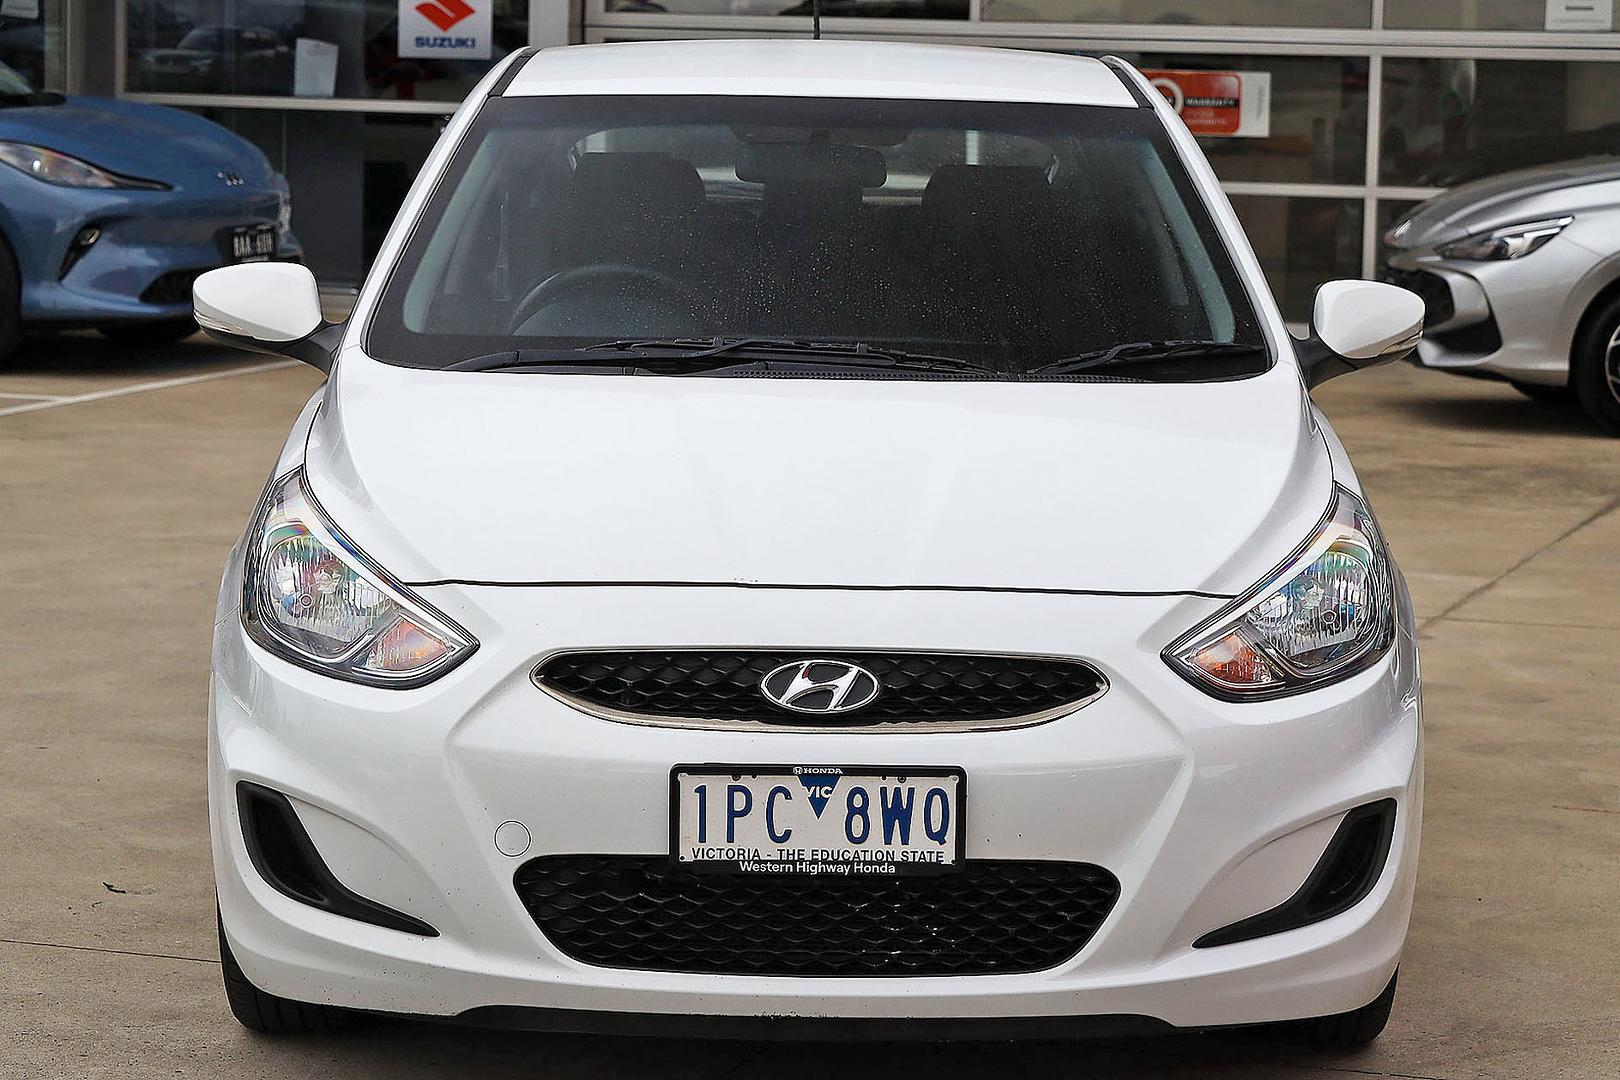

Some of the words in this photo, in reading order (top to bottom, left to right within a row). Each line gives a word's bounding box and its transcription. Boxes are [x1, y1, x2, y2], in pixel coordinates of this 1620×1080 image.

[415, 36, 476, 49] SUZUKI
[803, 767, 843, 775] HONDA
[803, 785, 833, 799] VIC
[693, 784, 793, 844] 1PC
[844, 786, 950, 846] 8WQ
[691, 847, 761, 860] VICTORIA
[776, 848, 806, 861] THE
[811, 849, 895, 862] EDUCATION
[900, 850, 945, 863] STATE
[739, 861, 793, 874] Western
[796, 862, 851, 876] Highway
[854, 863, 896, 874] Honda
